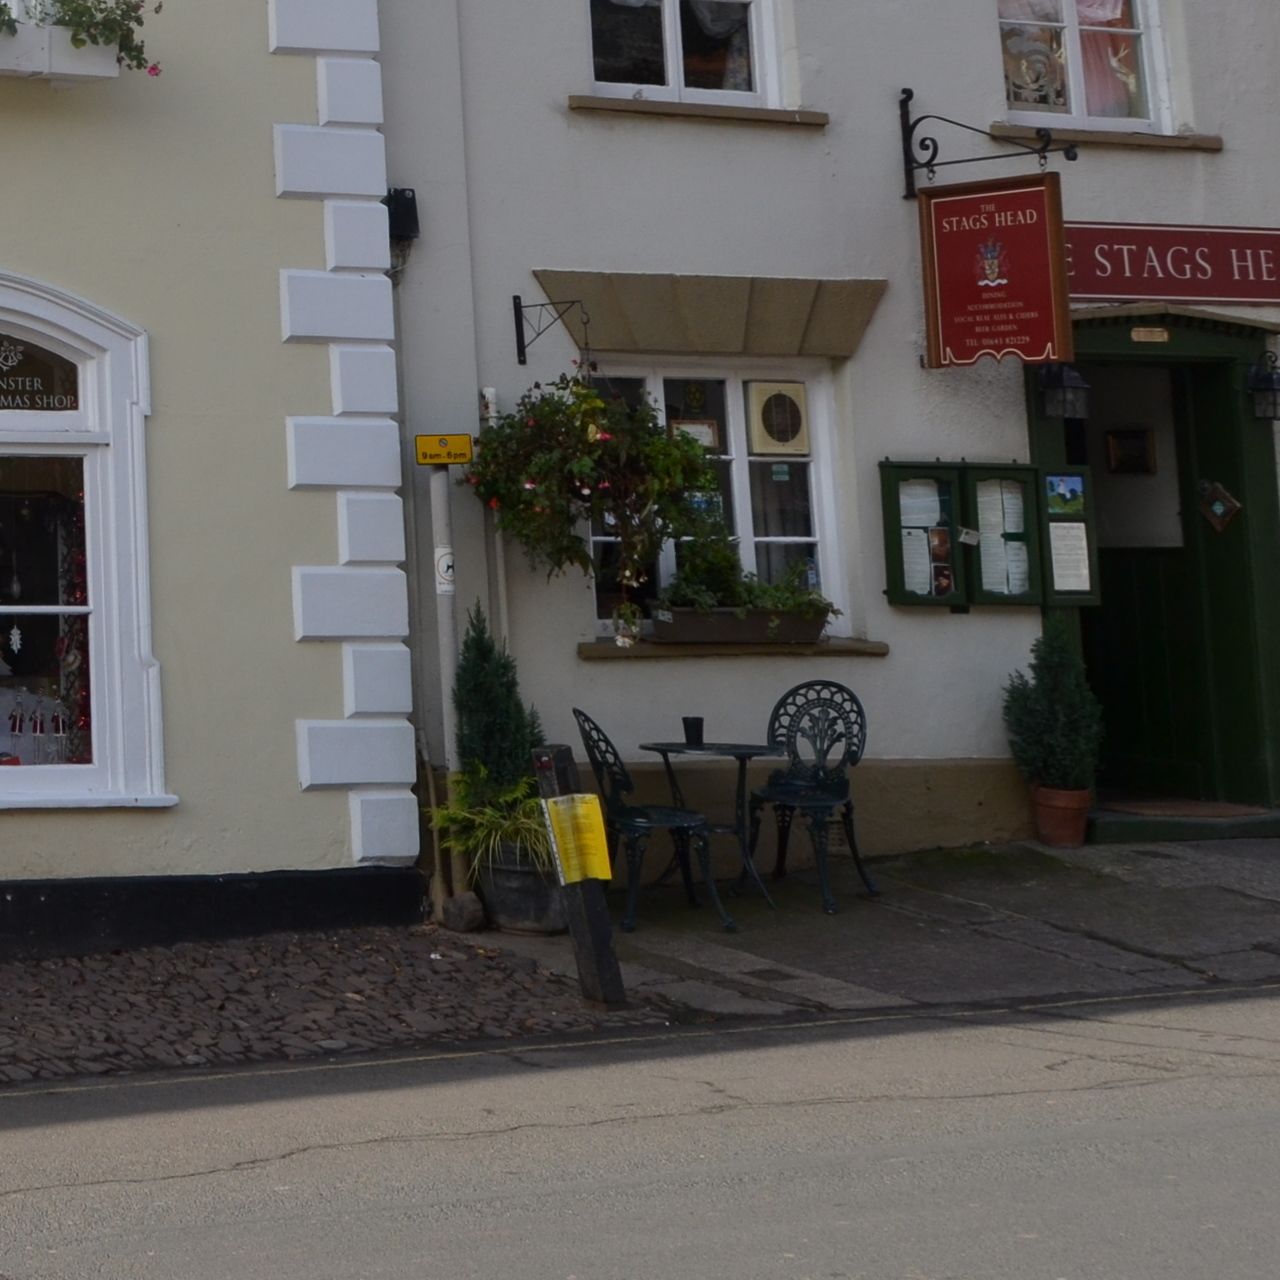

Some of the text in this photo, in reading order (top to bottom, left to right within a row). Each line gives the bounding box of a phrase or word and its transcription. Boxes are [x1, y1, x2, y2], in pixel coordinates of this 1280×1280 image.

[980, 203, 996, 212] THE
[942, 209, 1037, 232] STAGS HEAD
[1094, 243, 1212, 279] STAGS
[35, 394, 74, 409] SHOP
